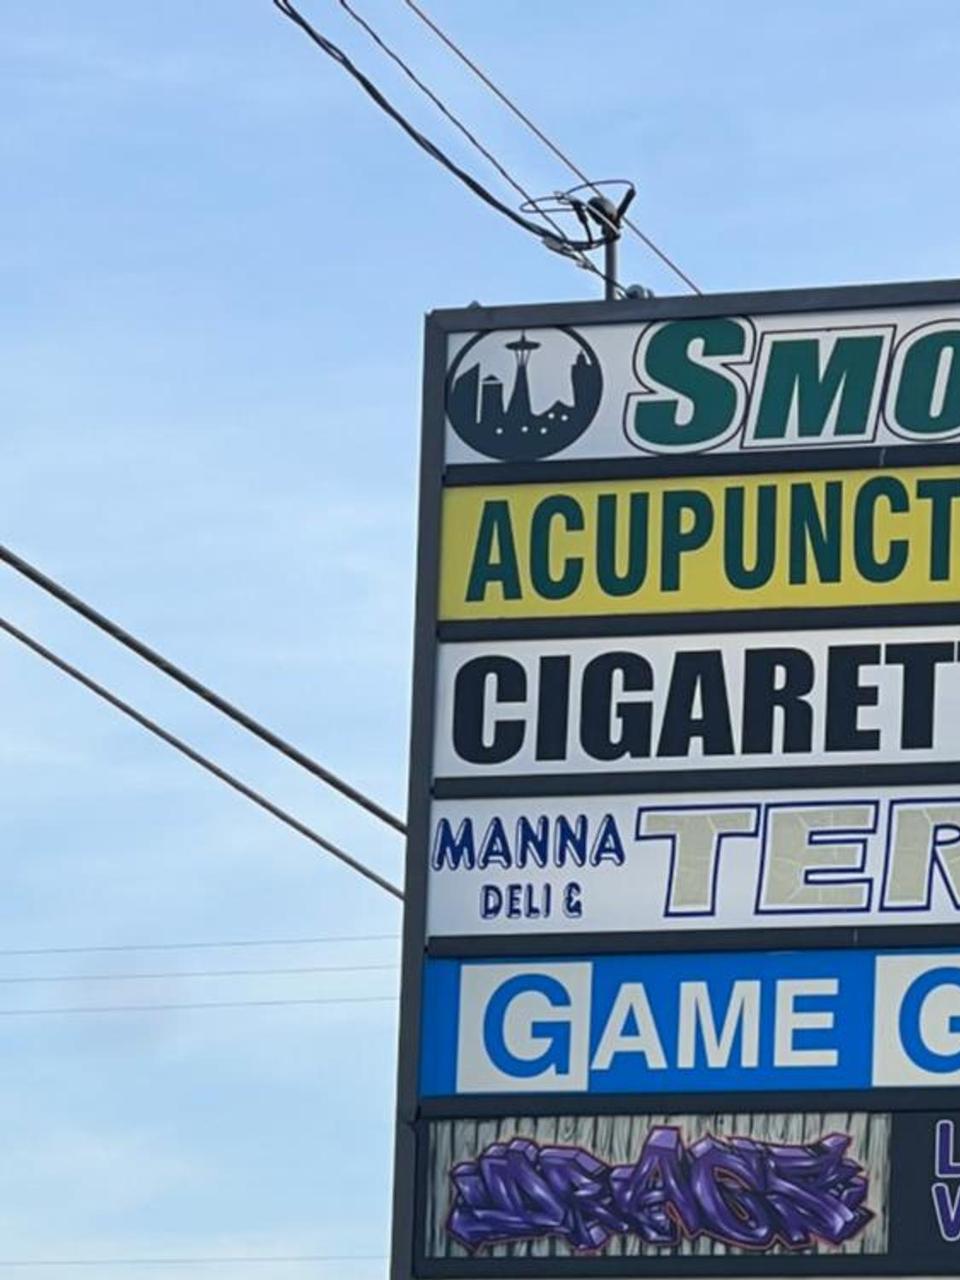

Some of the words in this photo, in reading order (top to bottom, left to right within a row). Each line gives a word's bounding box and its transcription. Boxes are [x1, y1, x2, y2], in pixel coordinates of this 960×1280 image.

[432, 814, 626, 871] MANNA
[480, 883, 551, 919] DELI
[565, 882, 582, 917] &
[482, 973, 839, 1078] GAME
